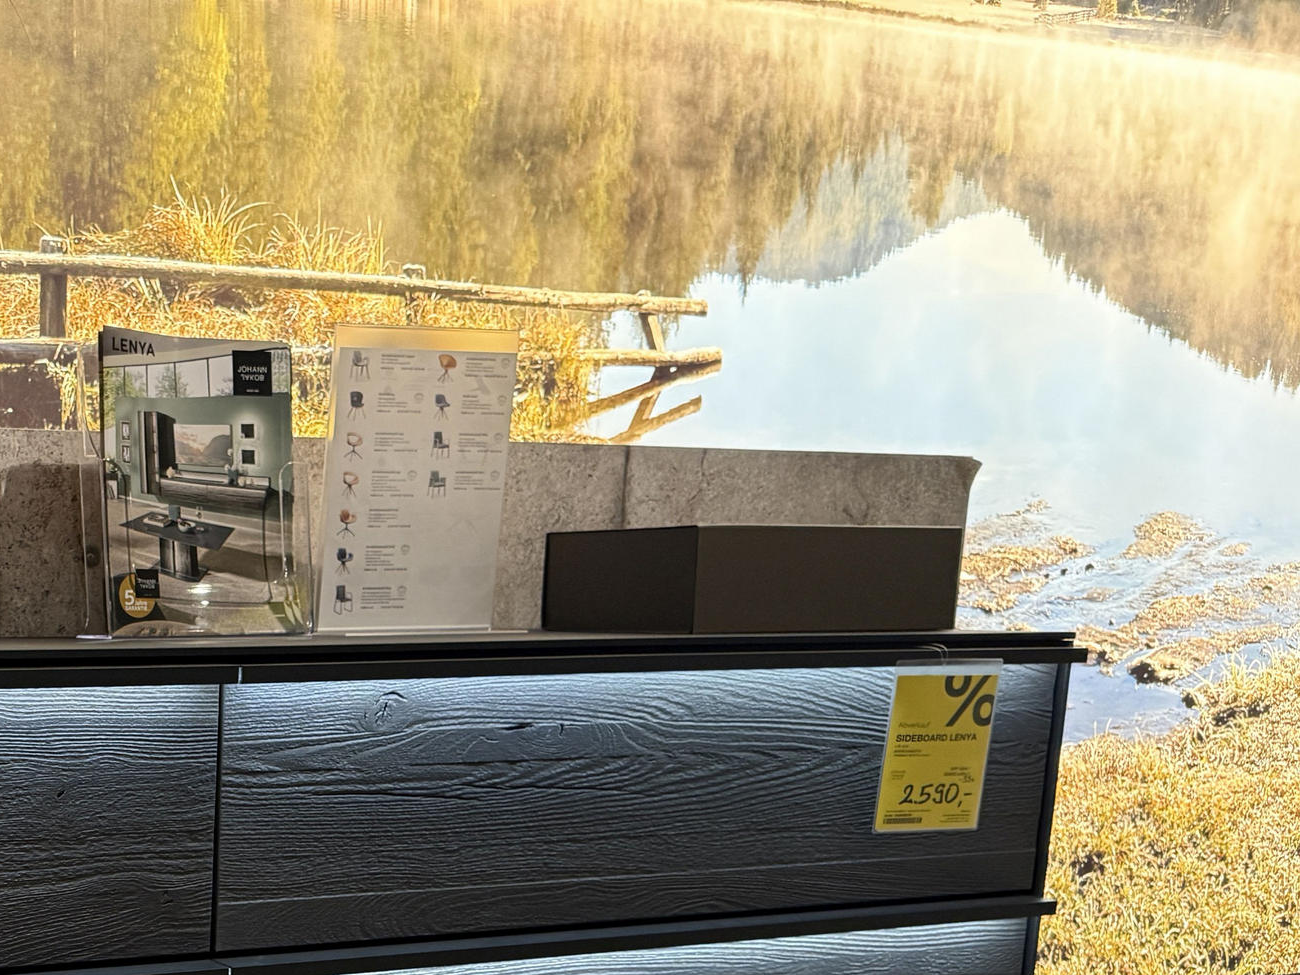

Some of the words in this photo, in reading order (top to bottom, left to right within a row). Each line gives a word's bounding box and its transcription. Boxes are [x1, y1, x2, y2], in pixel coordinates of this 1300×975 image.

[112, 337, 155, 357] LENYA
[237, 365, 267, 373] JOHANN
[124, 589, 135, 606] 5
[895, 734, 947, 742] SIDEBOARD
[949, 733, 977, 741] LENYA
